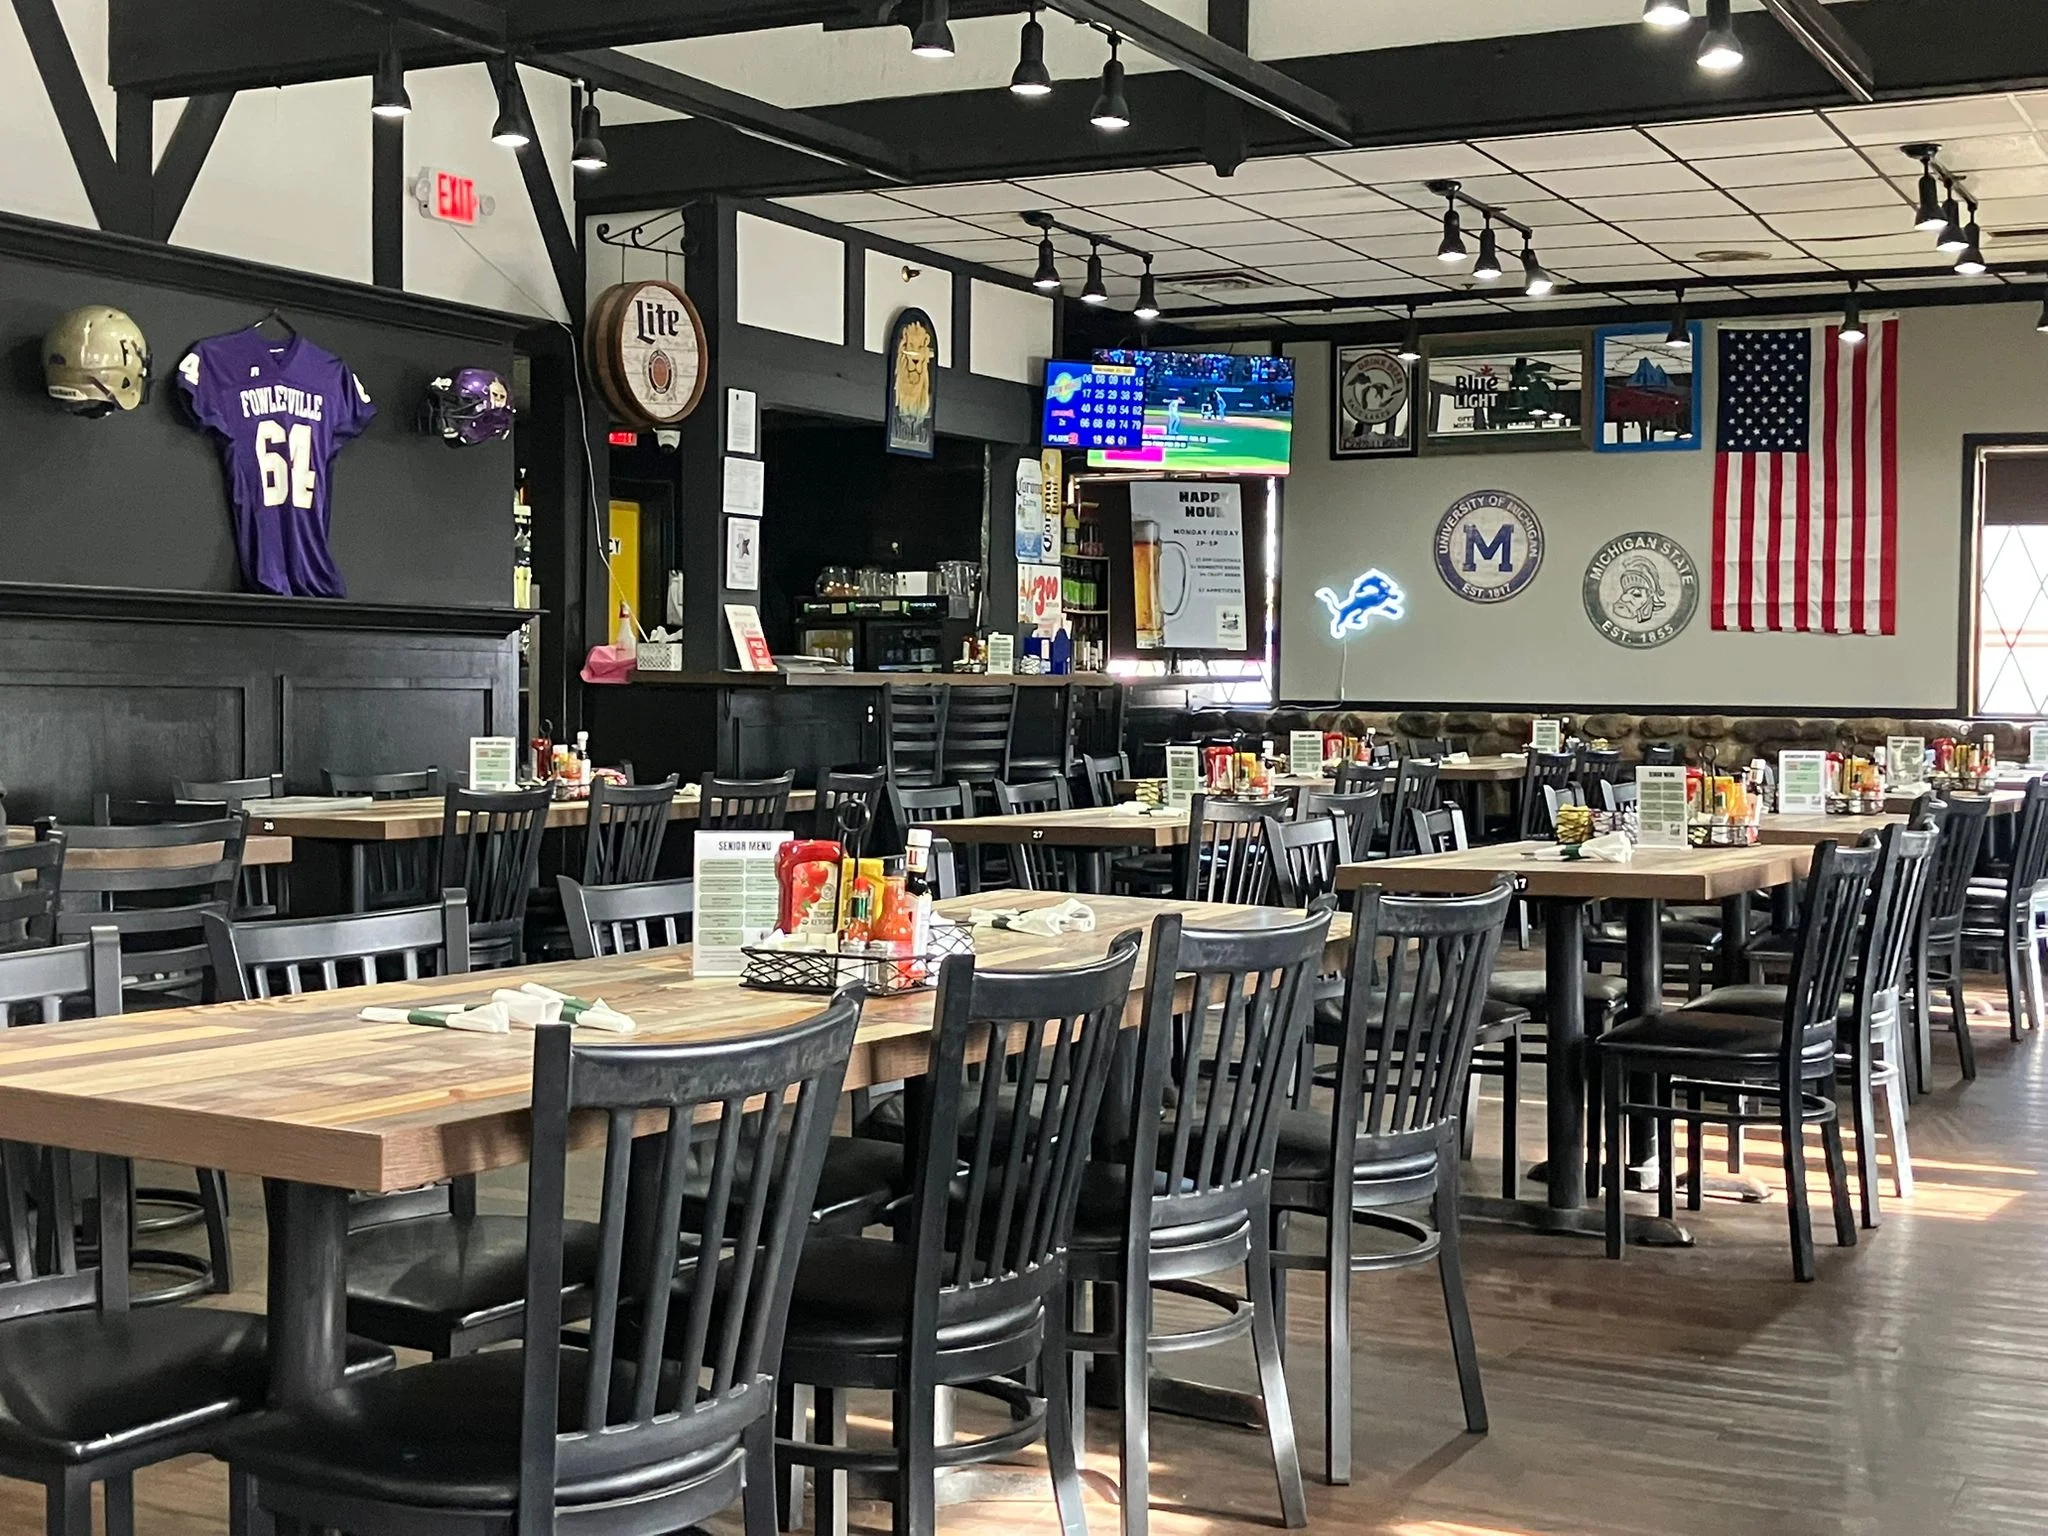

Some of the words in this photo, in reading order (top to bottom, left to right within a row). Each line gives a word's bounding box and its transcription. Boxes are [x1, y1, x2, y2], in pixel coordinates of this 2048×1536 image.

[437, 172, 475, 222] EXIT
[636, 299, 680, 345] Lite
[1122, 376, 1131, 385] 14
[1135, 377, 1144, 386] 15
[1456, 373, 1498, 391] Blue
[1082, 389, 1092, 398] 17
[1455, 393, 1498, 408] LIGHT
[239, 385, 323, 422] FOWLEVILLE
[1080, 403, 1091, 413] 40
[1093, 404, 1104, 414] 45
[1107, 404, 1117, 414] 50
[1119, 405, 1129, 415] 54
[1119, 420, 1129, 429] 74
[1179, 491, 1228, 503] HAPP
[1439, 496, 1485, 554] UNIVERSITY
[1489, 496, 1507, 507] OF
[1507, 501, 1538, 558] MICHIGAN
[1462, 524, 1514, 572] M
[1590, 537, 1657, 580] MICHIGAN
[1661, 543, 1693, 585] STATE
[1488, 583, 1511, 598] 1817
[1602, 621, 1631, 643] EST.
[1640, 624, 1674, 642] 1855
[719, 841, 746, 851] SENIOR
[748, 841, 772, 851] MENU
[1514, 878, 1526, 889] 17
